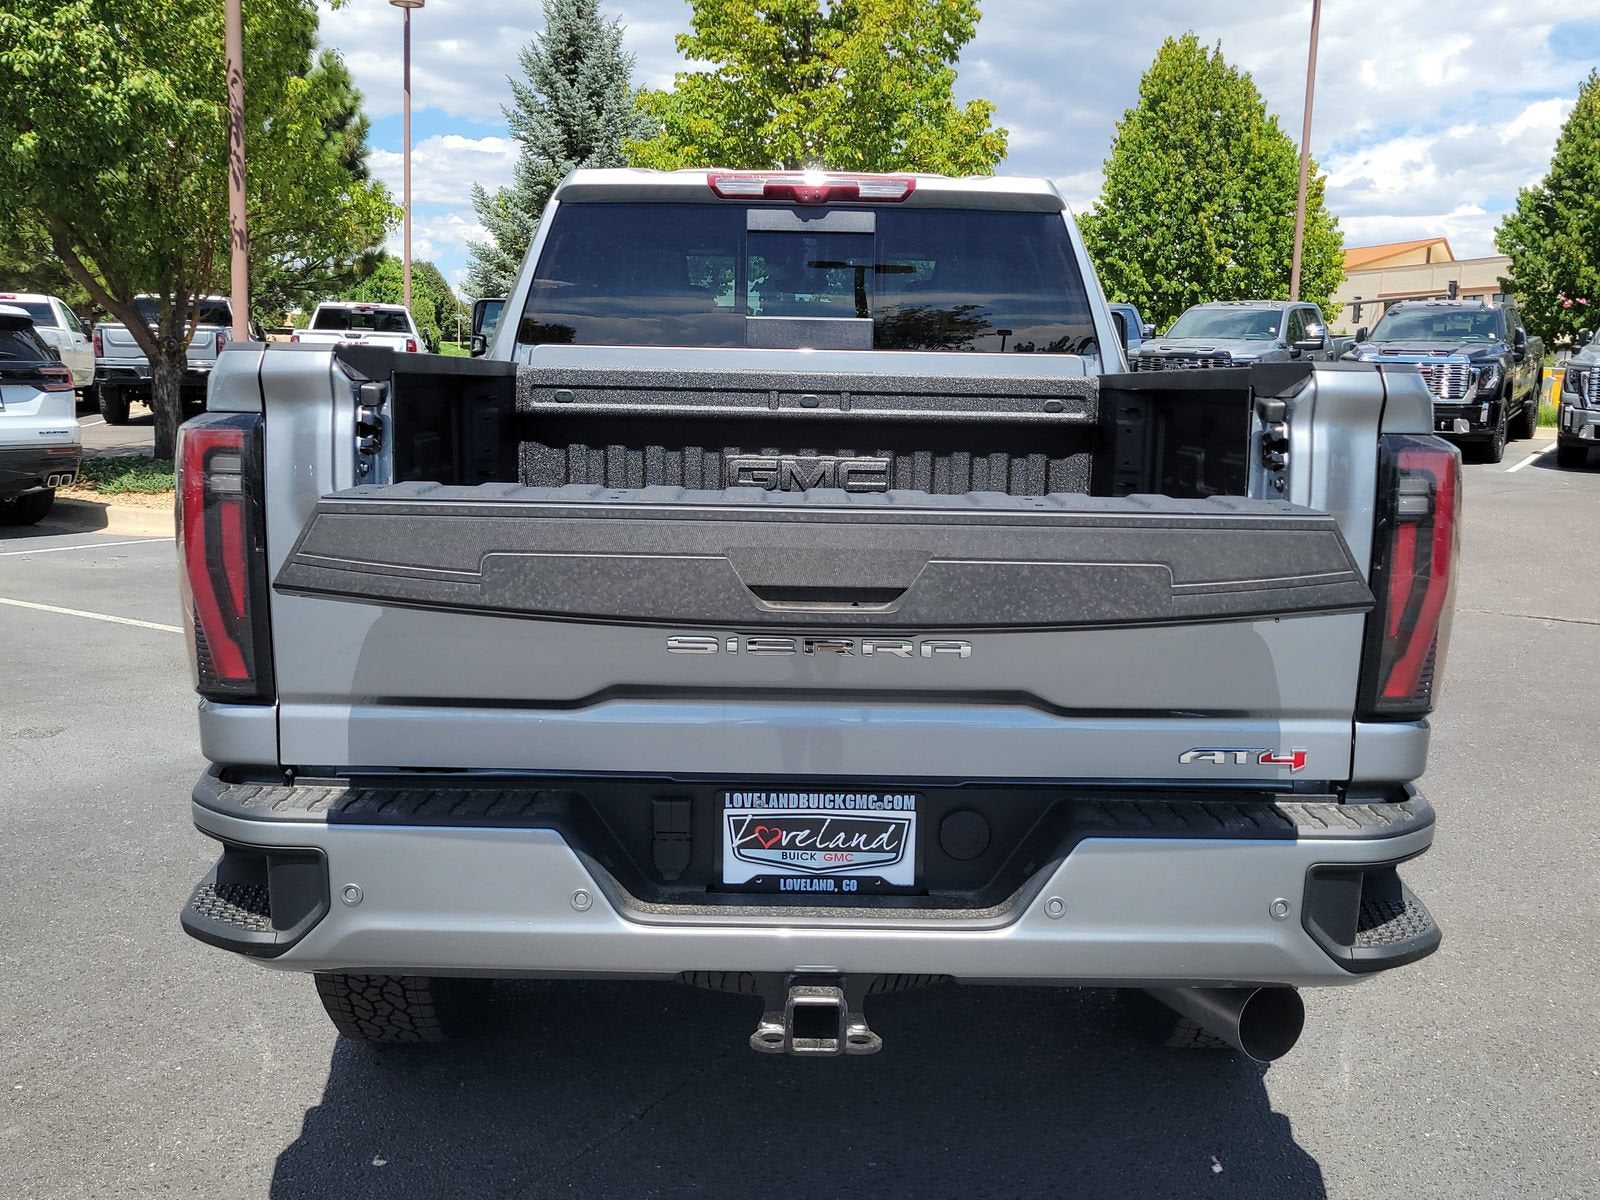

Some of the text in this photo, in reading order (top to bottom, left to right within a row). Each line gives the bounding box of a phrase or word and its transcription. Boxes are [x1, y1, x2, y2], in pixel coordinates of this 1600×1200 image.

[727, 456, 889, 491] GMC
[666, 635, 973, 659] SIERRA
[1179, 746, 1307, 774] AT4
[724, 792, 916, 811] LOVELANDBUICKGMC.COM
[781, 851, 855, 863] BUICK GMC
[779, 878, 858, 893] LOVELAND, CO
